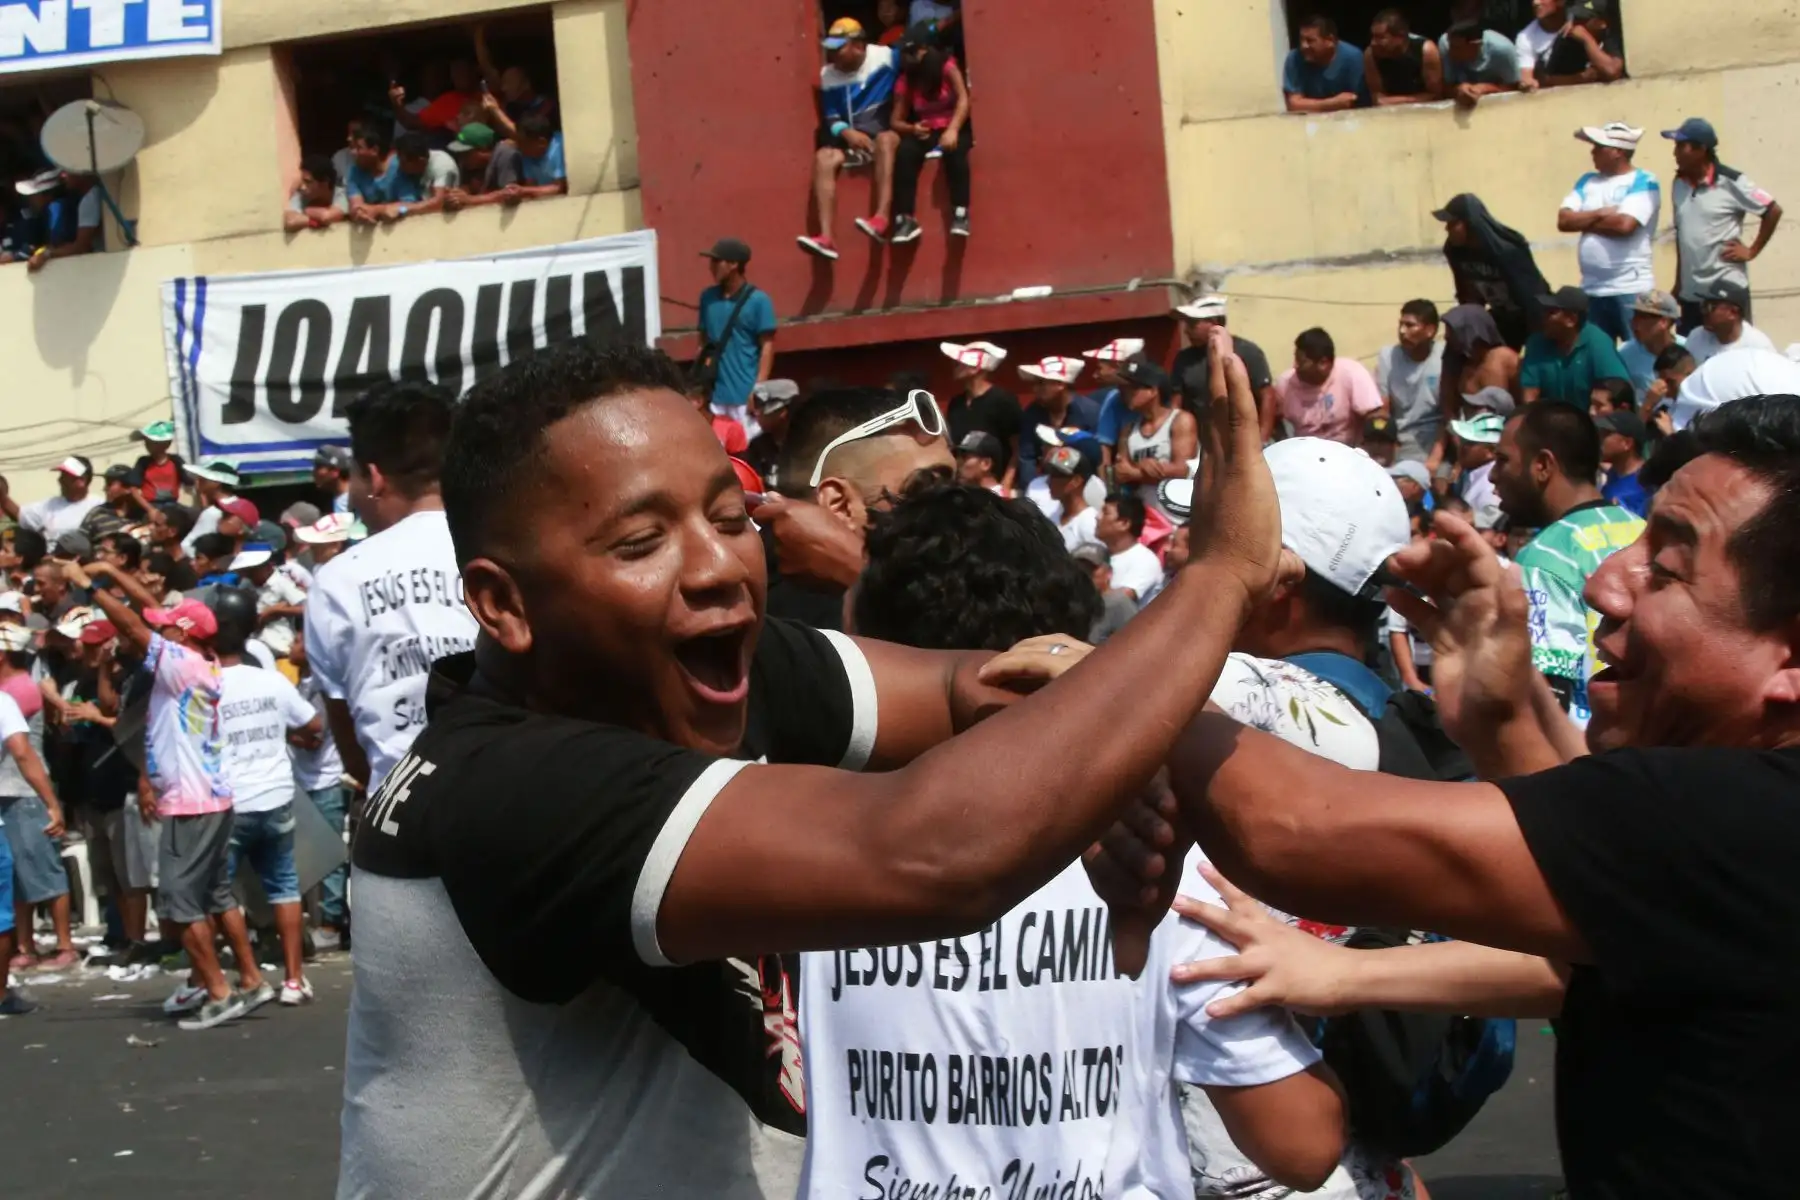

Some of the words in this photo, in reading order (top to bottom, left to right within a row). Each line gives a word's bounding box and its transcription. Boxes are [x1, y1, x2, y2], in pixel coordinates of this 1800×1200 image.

[411, 568, 431, 604] ES
[434, 570, 451, 607] EL
[933, 938, 970, 992] ES
[979, 919, 1007, 991] EL
[1016, 907, 1143, 987] CAMIN
[847, 1049, 938, 1124] PURITO
[948, 1052, 1052, 1127] BARRIOS
[1059, 1045, 1123, 1122] ALTOS
